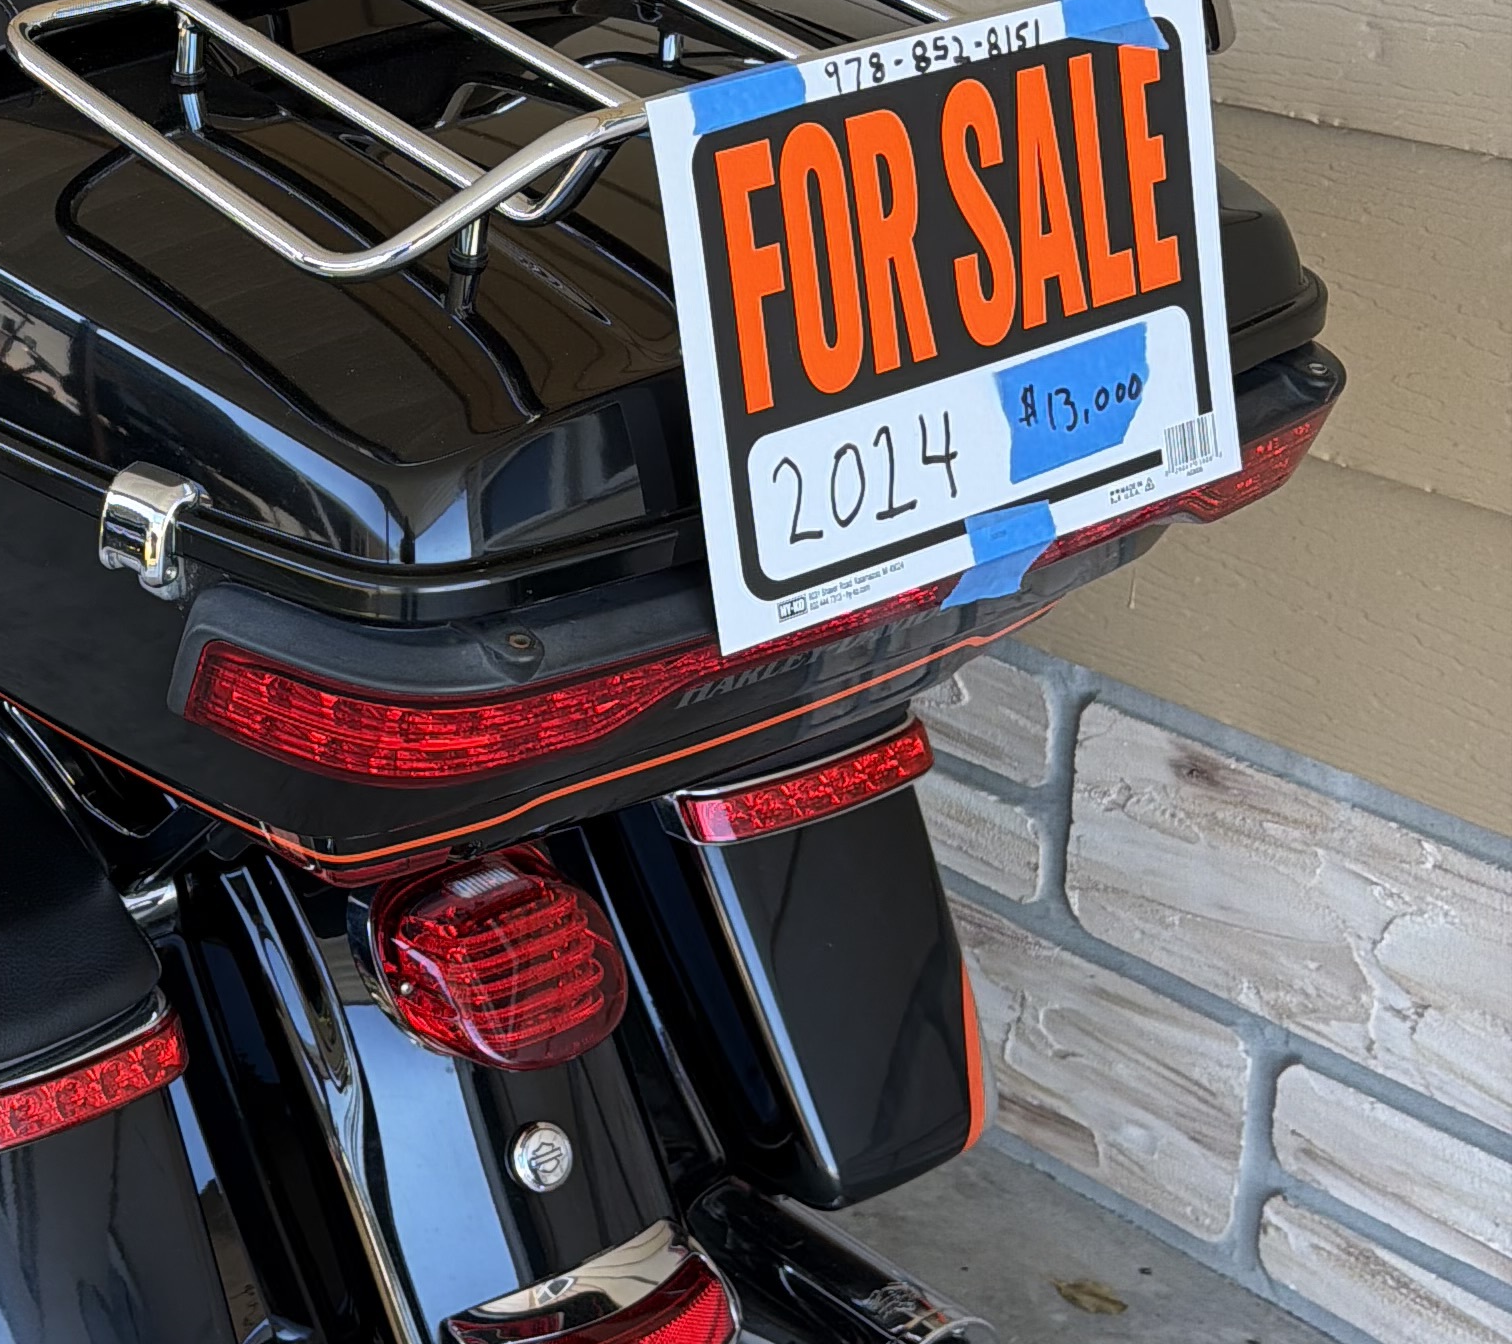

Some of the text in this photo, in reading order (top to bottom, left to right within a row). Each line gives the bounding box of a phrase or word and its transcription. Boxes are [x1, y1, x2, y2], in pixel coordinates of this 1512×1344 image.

[824, 18, 1041, 95] 978-852-8151
[714, 43, 1182, 415] FOR SALE
[1019, 372, 1143, 432] $13,000
[772, 410, 959, 545] 2014
[779, 598, 805, 618] HY-KO
